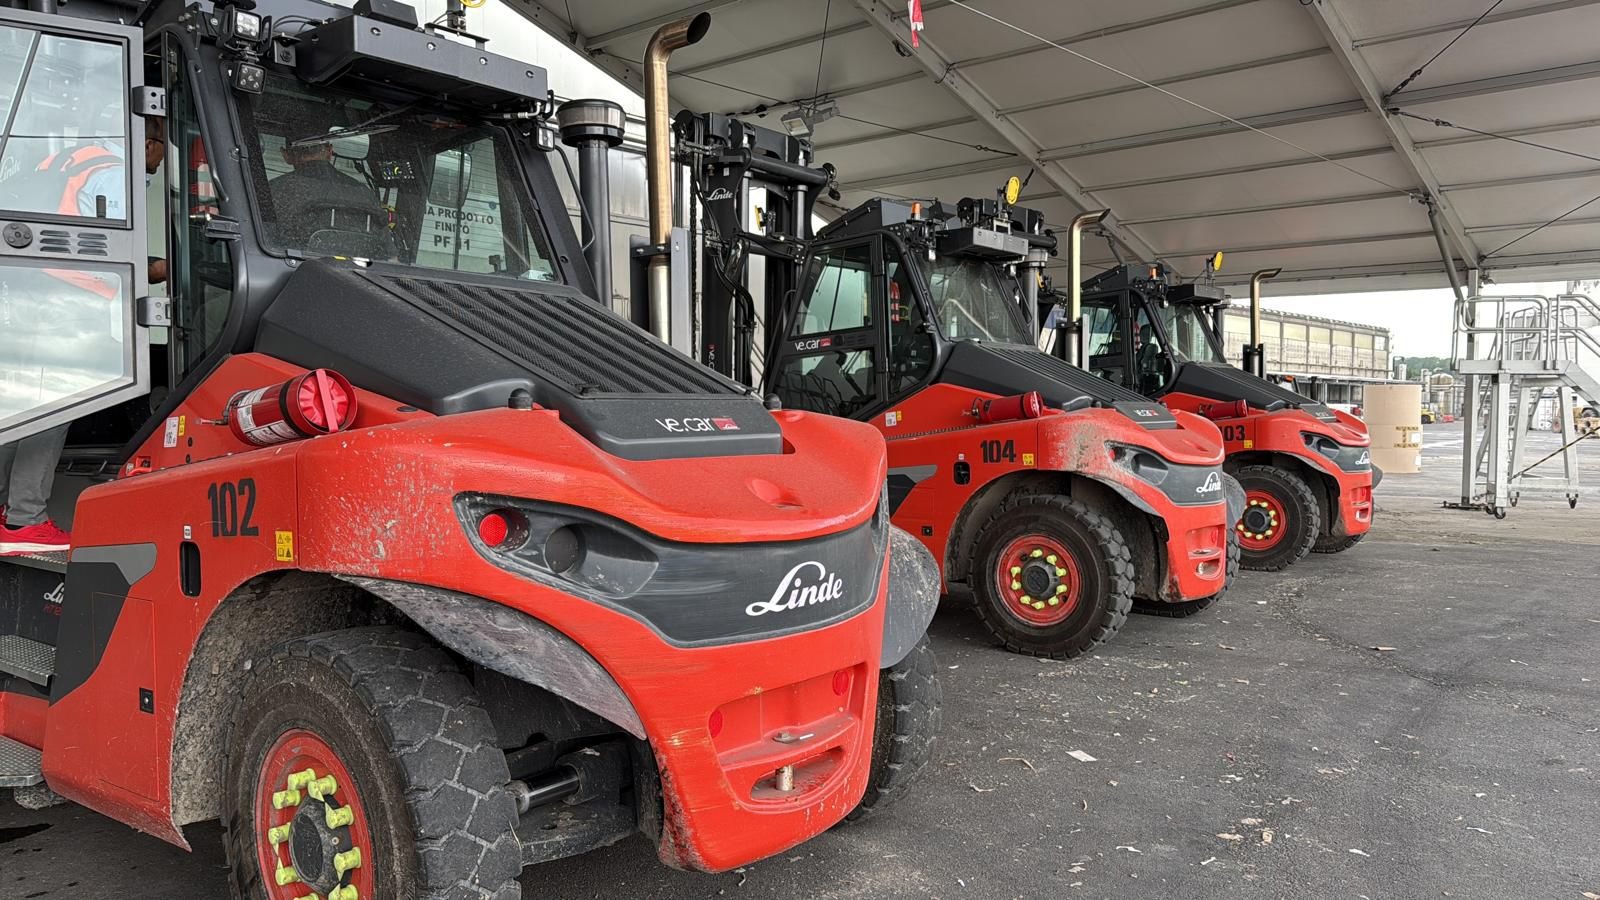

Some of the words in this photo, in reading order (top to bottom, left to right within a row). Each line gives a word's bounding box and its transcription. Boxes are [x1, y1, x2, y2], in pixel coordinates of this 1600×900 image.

[706, 187, 733, 201] Linde
[435, 221, 470, 234] FINIO
[794, 339, 820, 351] ve.car
[655, 417, 715, 432] ve.car
[1218, 424, 1246, 441] 03
[980, 439, 1016, 463] 104
[207, 477, 259, 538] 102
[745, 560, 843, 617] Linde
